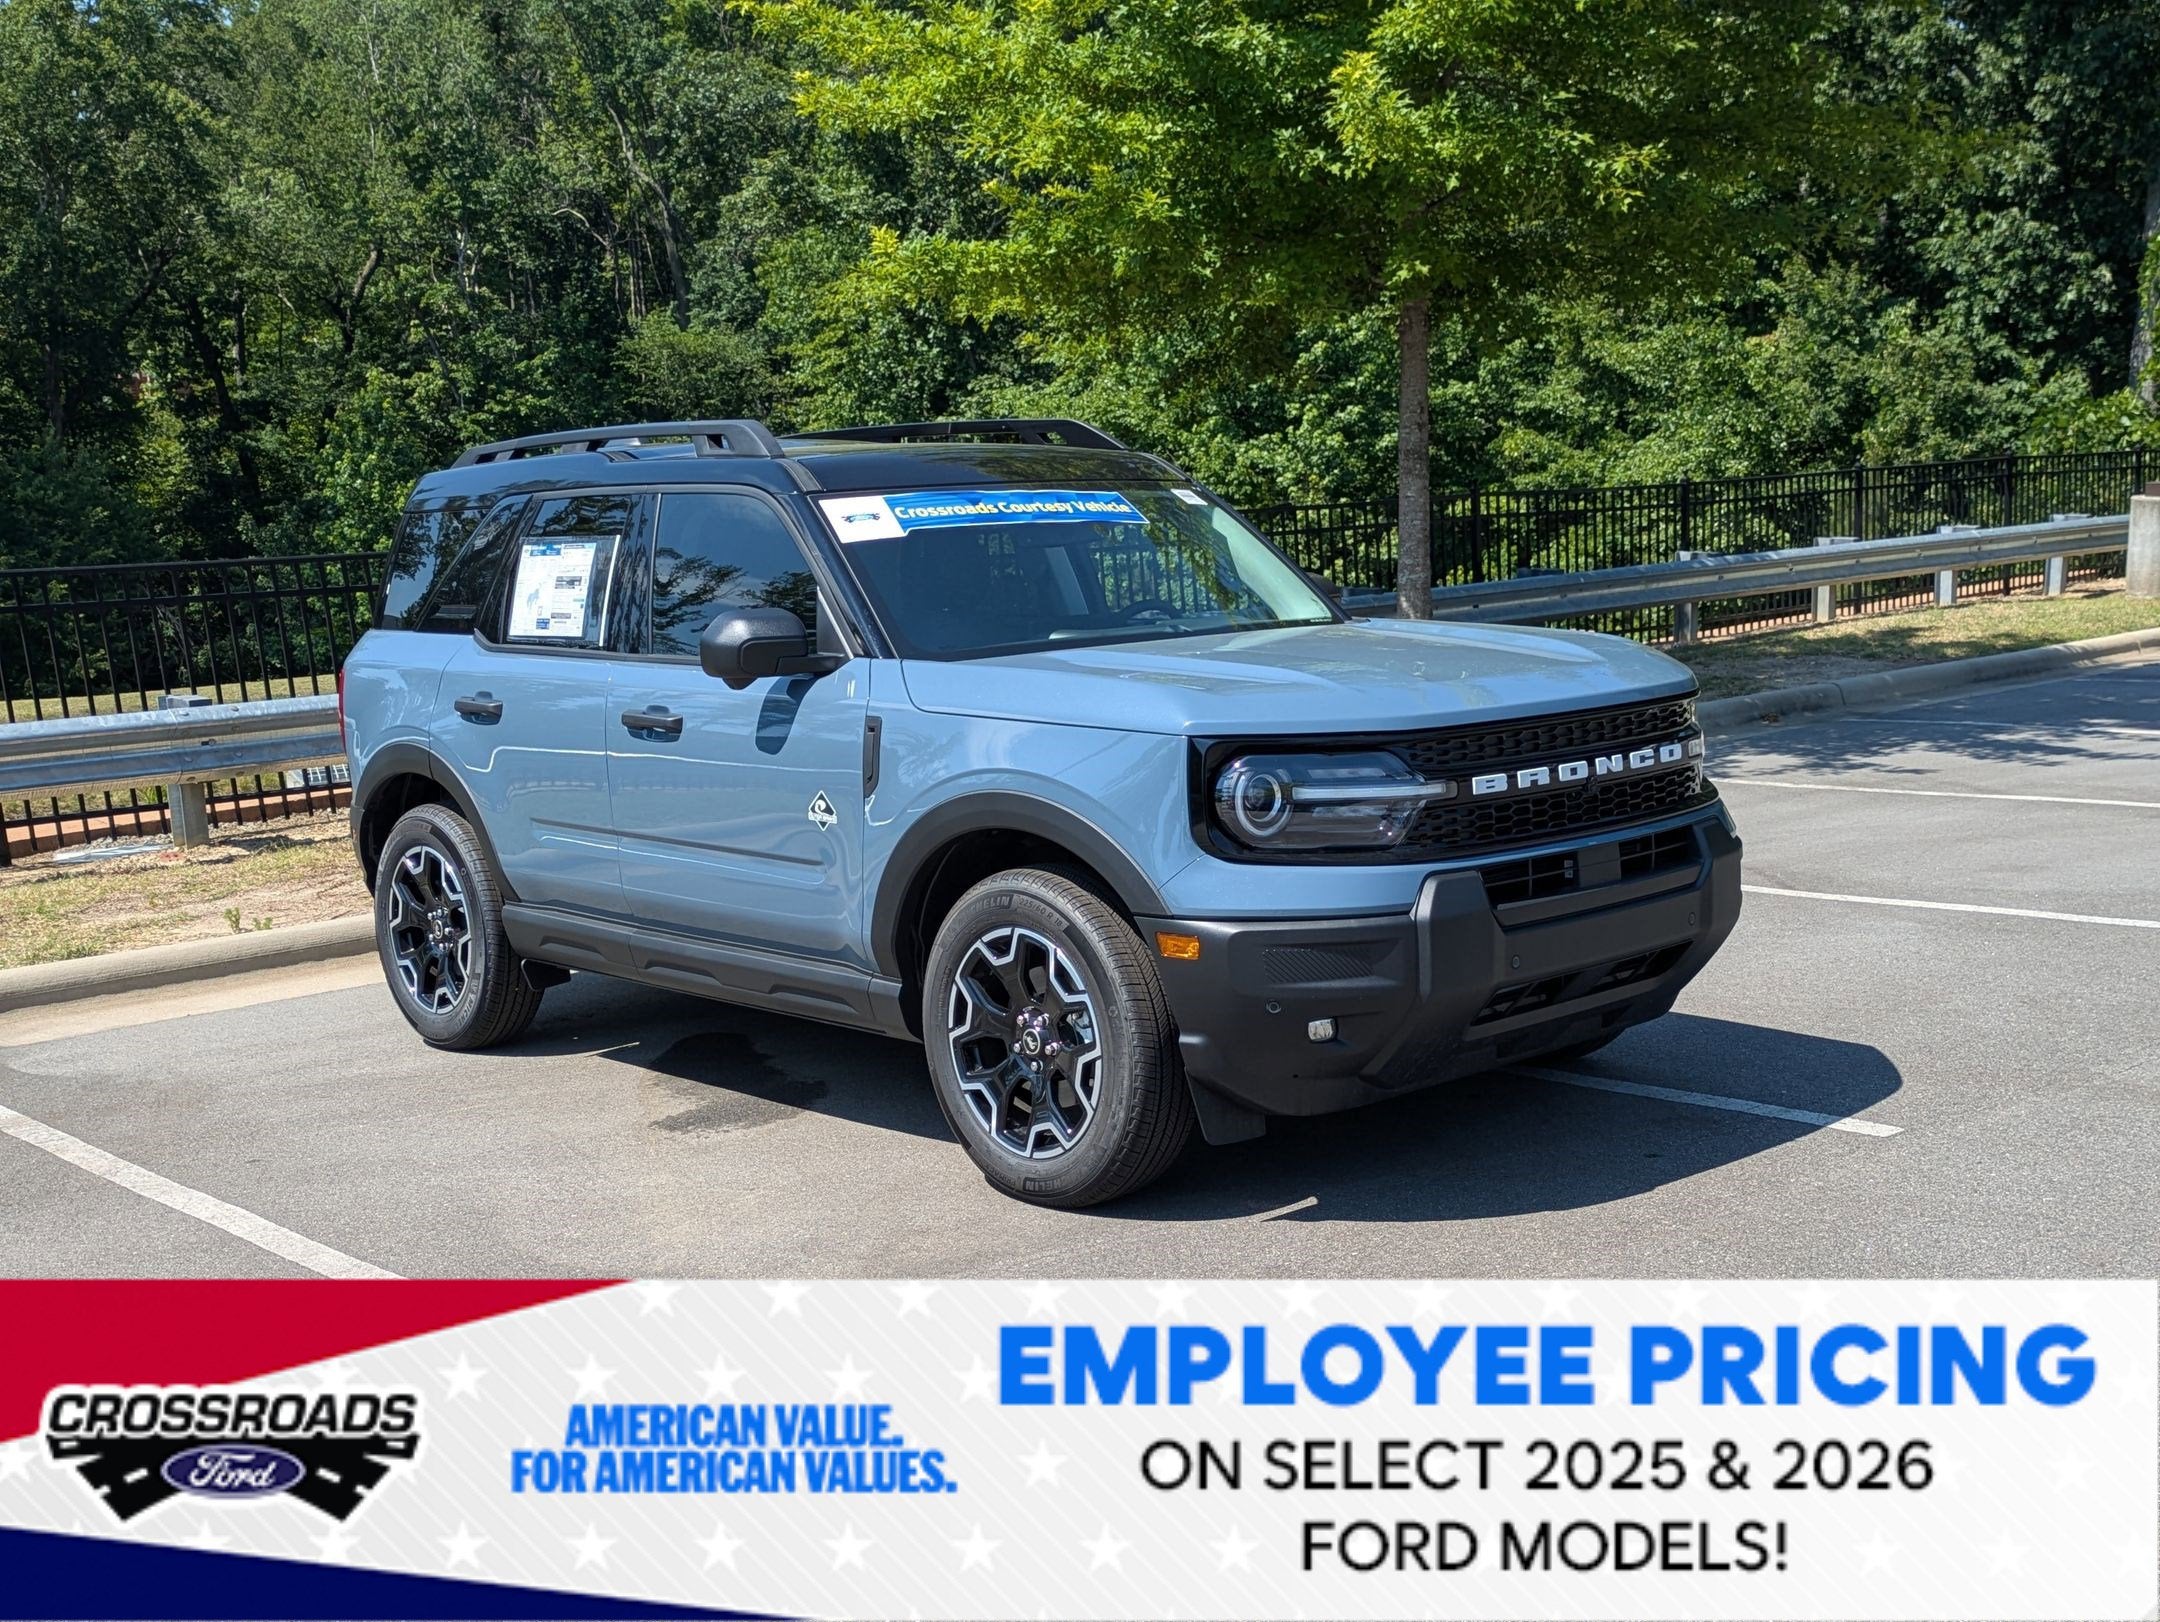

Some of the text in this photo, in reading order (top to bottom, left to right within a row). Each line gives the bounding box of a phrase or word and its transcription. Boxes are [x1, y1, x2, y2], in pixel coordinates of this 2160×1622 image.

[893, 502, 996, 519] Crossroads
[998, 501, 1073, 514] Courtesy
[1071, 501, 1131, 513] Vehicle
[1472, 743, 1682, 796] BRONCO
